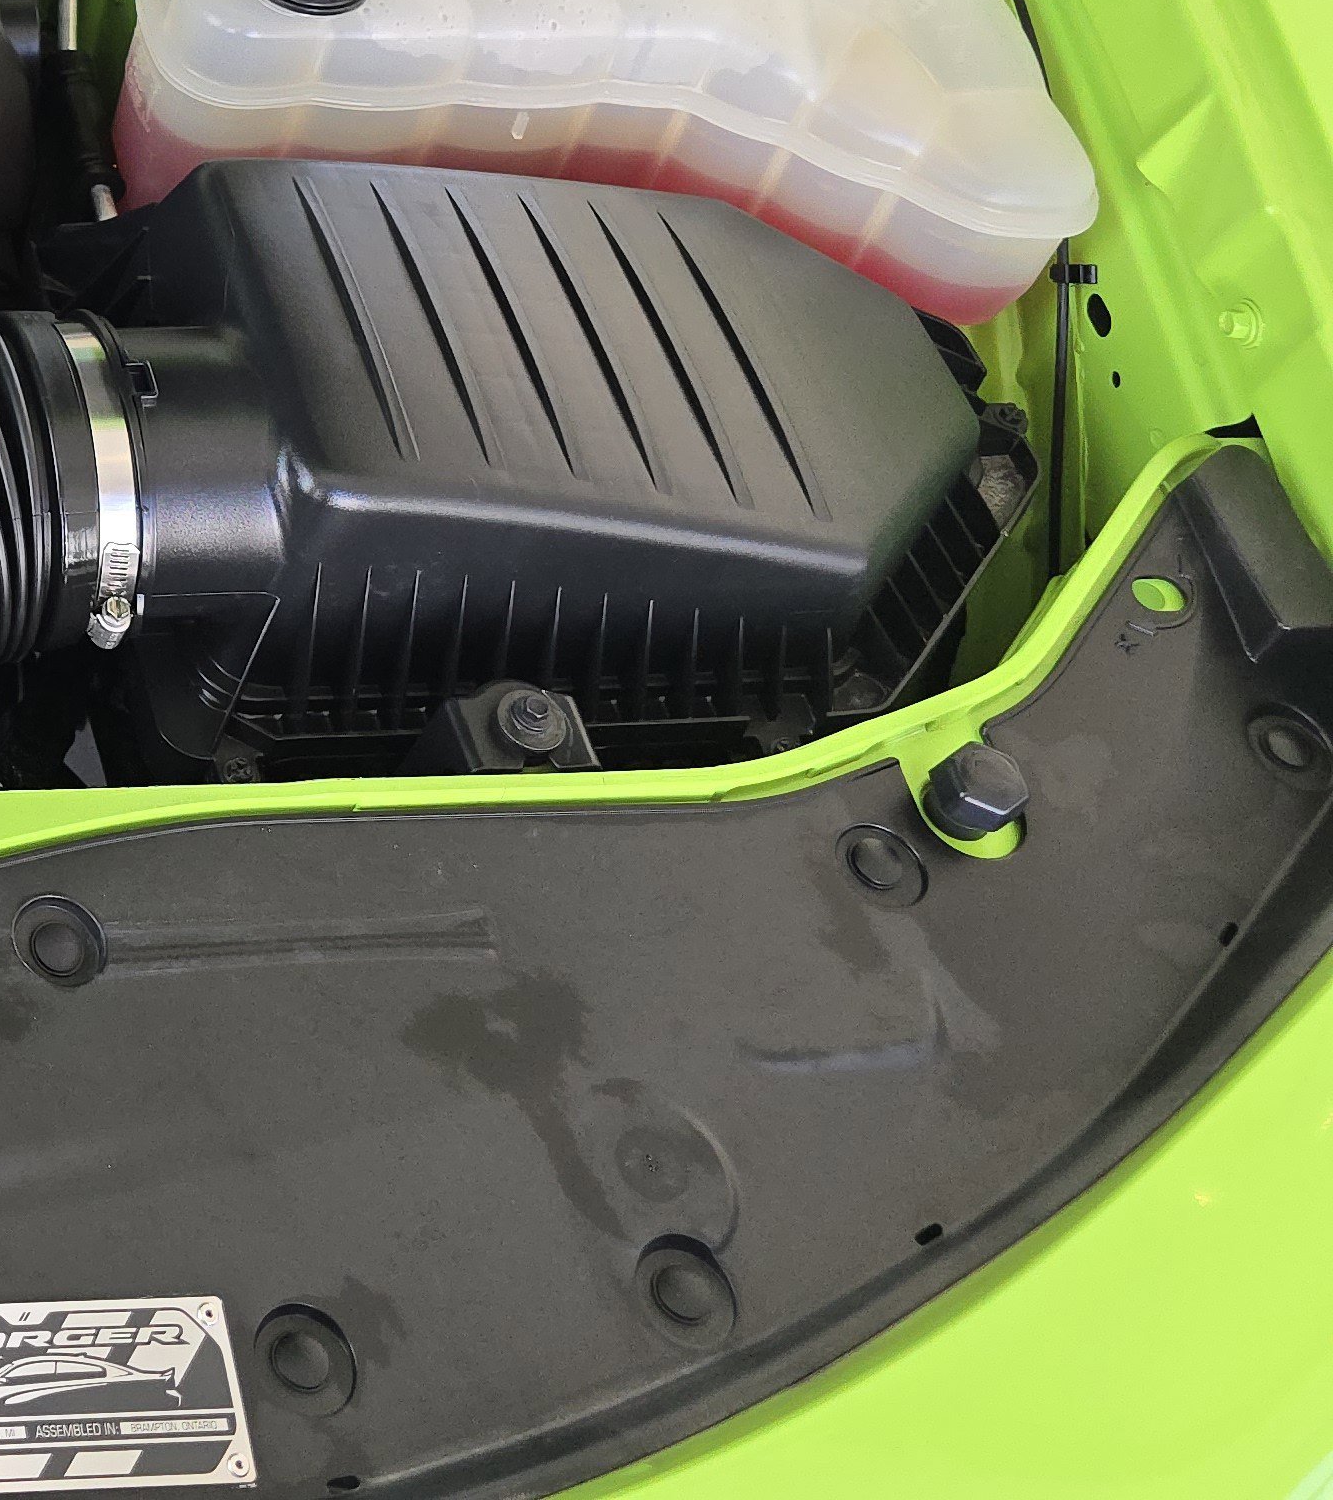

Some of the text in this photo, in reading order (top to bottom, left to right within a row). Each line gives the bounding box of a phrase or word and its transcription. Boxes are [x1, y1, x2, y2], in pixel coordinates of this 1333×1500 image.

[4, 1428, 17, 1438] MI
[36, 1423, 102, 1438] ASSEMBLED
[104, 1422, 120, 1435] IN:
[182, 1419, 218, 1431] ONTARIO
